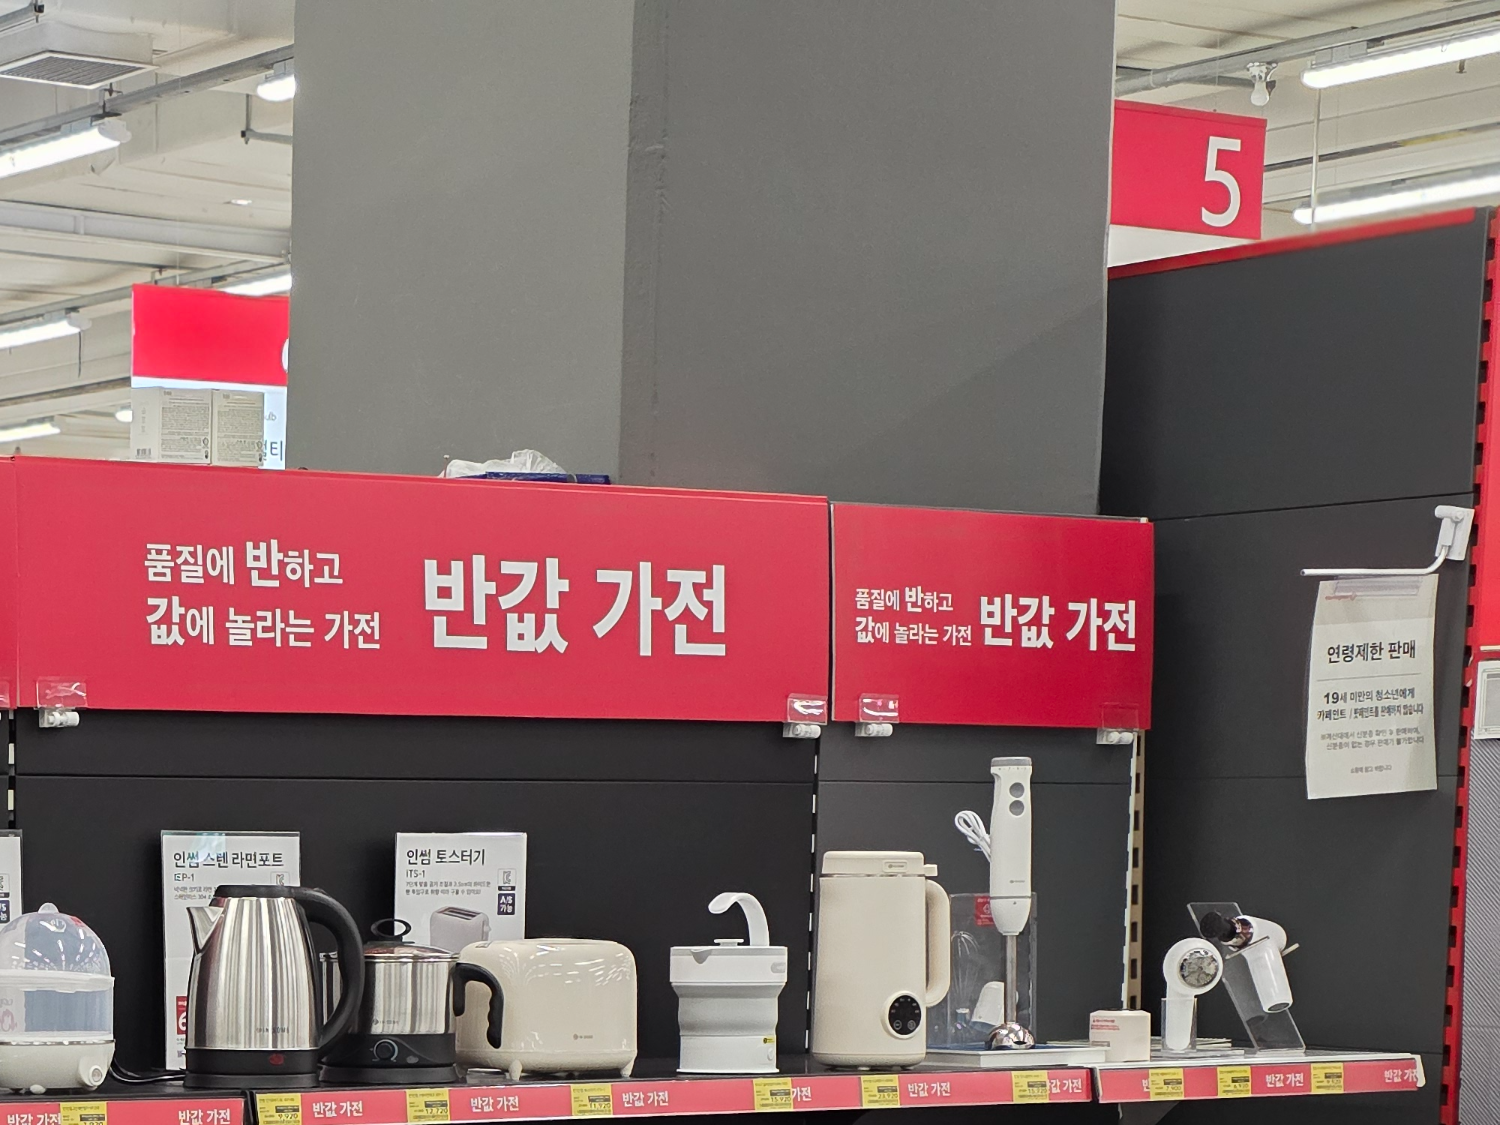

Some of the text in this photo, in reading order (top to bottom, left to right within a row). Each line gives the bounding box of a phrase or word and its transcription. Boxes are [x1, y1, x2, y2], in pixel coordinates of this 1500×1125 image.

[1201, 136, 1241, 228] 5
[145, 539, 343, 587] 품질에 반하고
[425, 555, 725, 656] 반값 가전
[856, 586, 953, 612] 품질에 반하고
[147, 596, 379, 649] 값에 놀라는 가전
[856, 617, 971, 645] 값에 놀라는 가전
[981, 594, 1135, 651] 반값 가전
[1327, 640, 1415, 664] 연령제한 판매
[1324, 687, 1415, 704] 19세 미만의 청소년에게
[173, 852, 284, 868] 인썸 스텐 라면포트
[406, 849, 485, 865] 인썸 토스터기
[908, 1082, 951, 1097] 반값 가전
[1266, 1073, 1304, 1088] 반값 가전
[312, 1101, 363, 1117] 반값 가전
[622, 1091, 669, 1107] 반값 가전
[178, 1108, 231, 1125] 반값 가전
